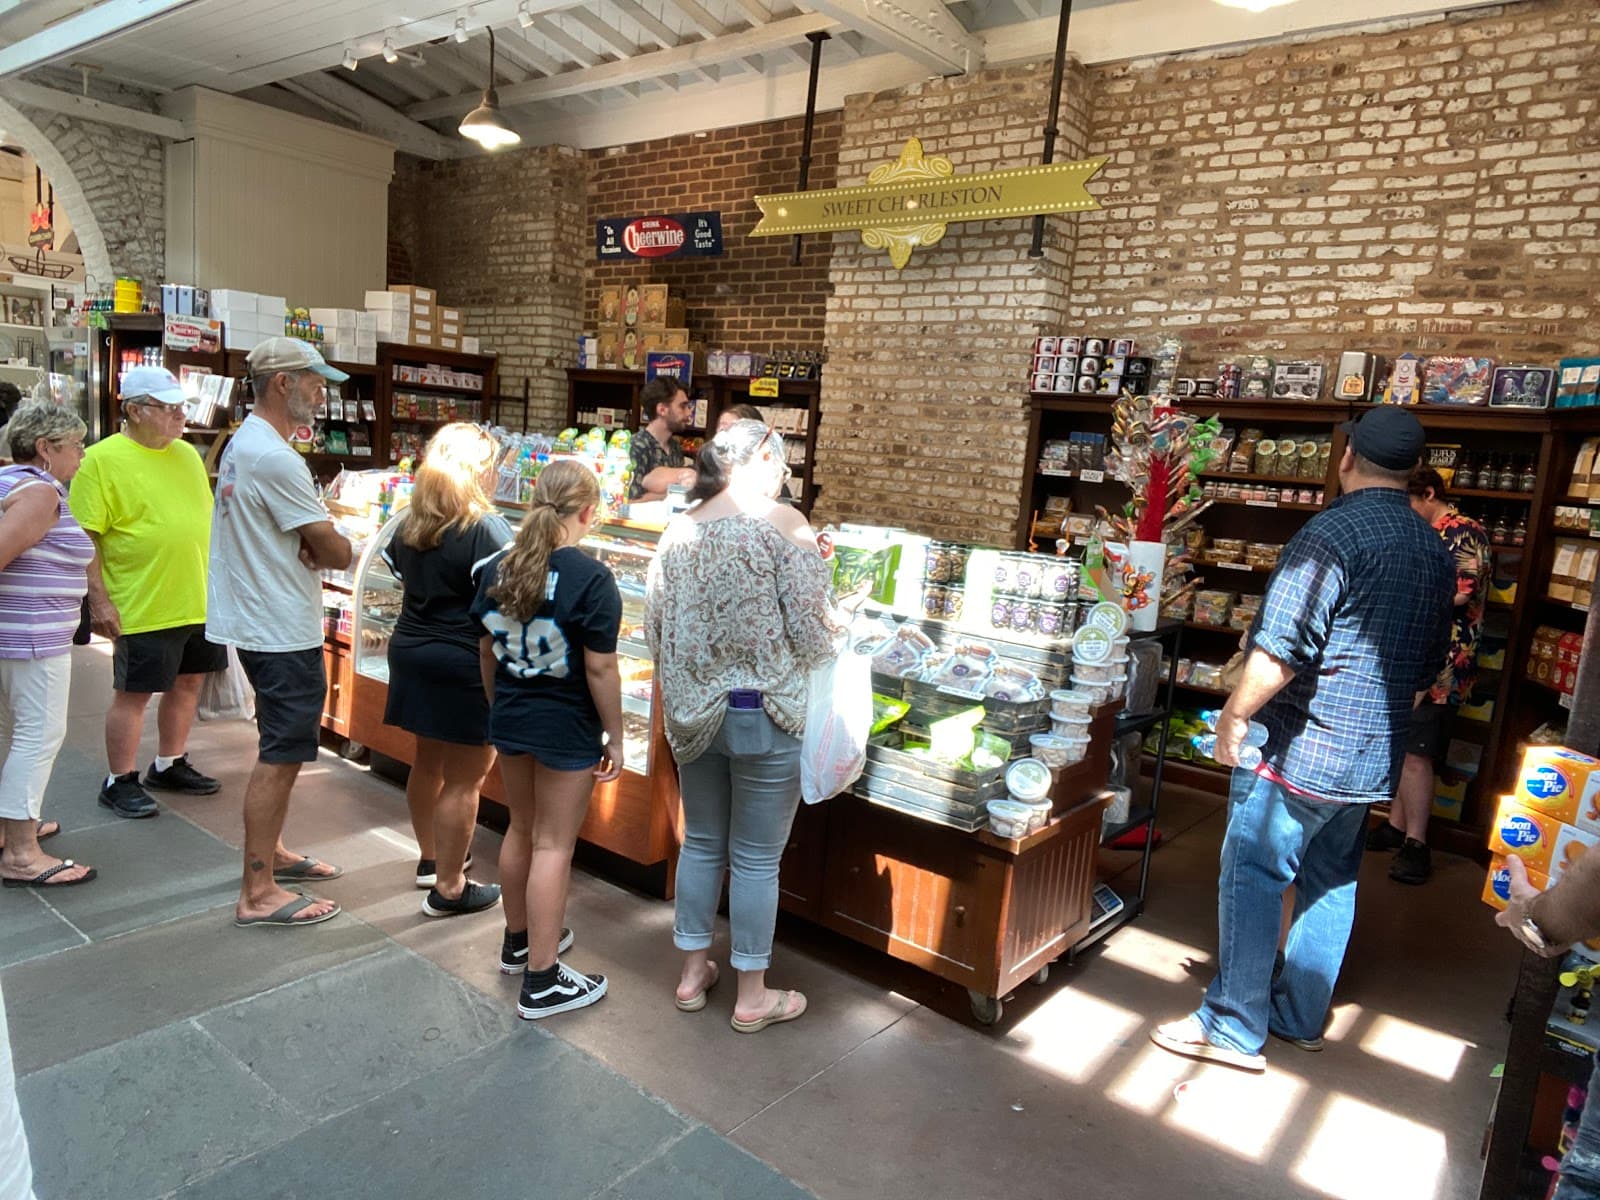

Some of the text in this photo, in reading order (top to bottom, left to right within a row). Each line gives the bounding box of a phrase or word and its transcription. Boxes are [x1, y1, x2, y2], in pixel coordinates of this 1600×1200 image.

[822, 198, 876, 218] SWEET
[624, 225, 685, 253] Cheerwine
[694, 229, 712, 239] Good
[1542, 780, 1563, 793] Pie
[1517, 830, 1537, 842] Pie
[1491, 870, 1512, 882] Mo
